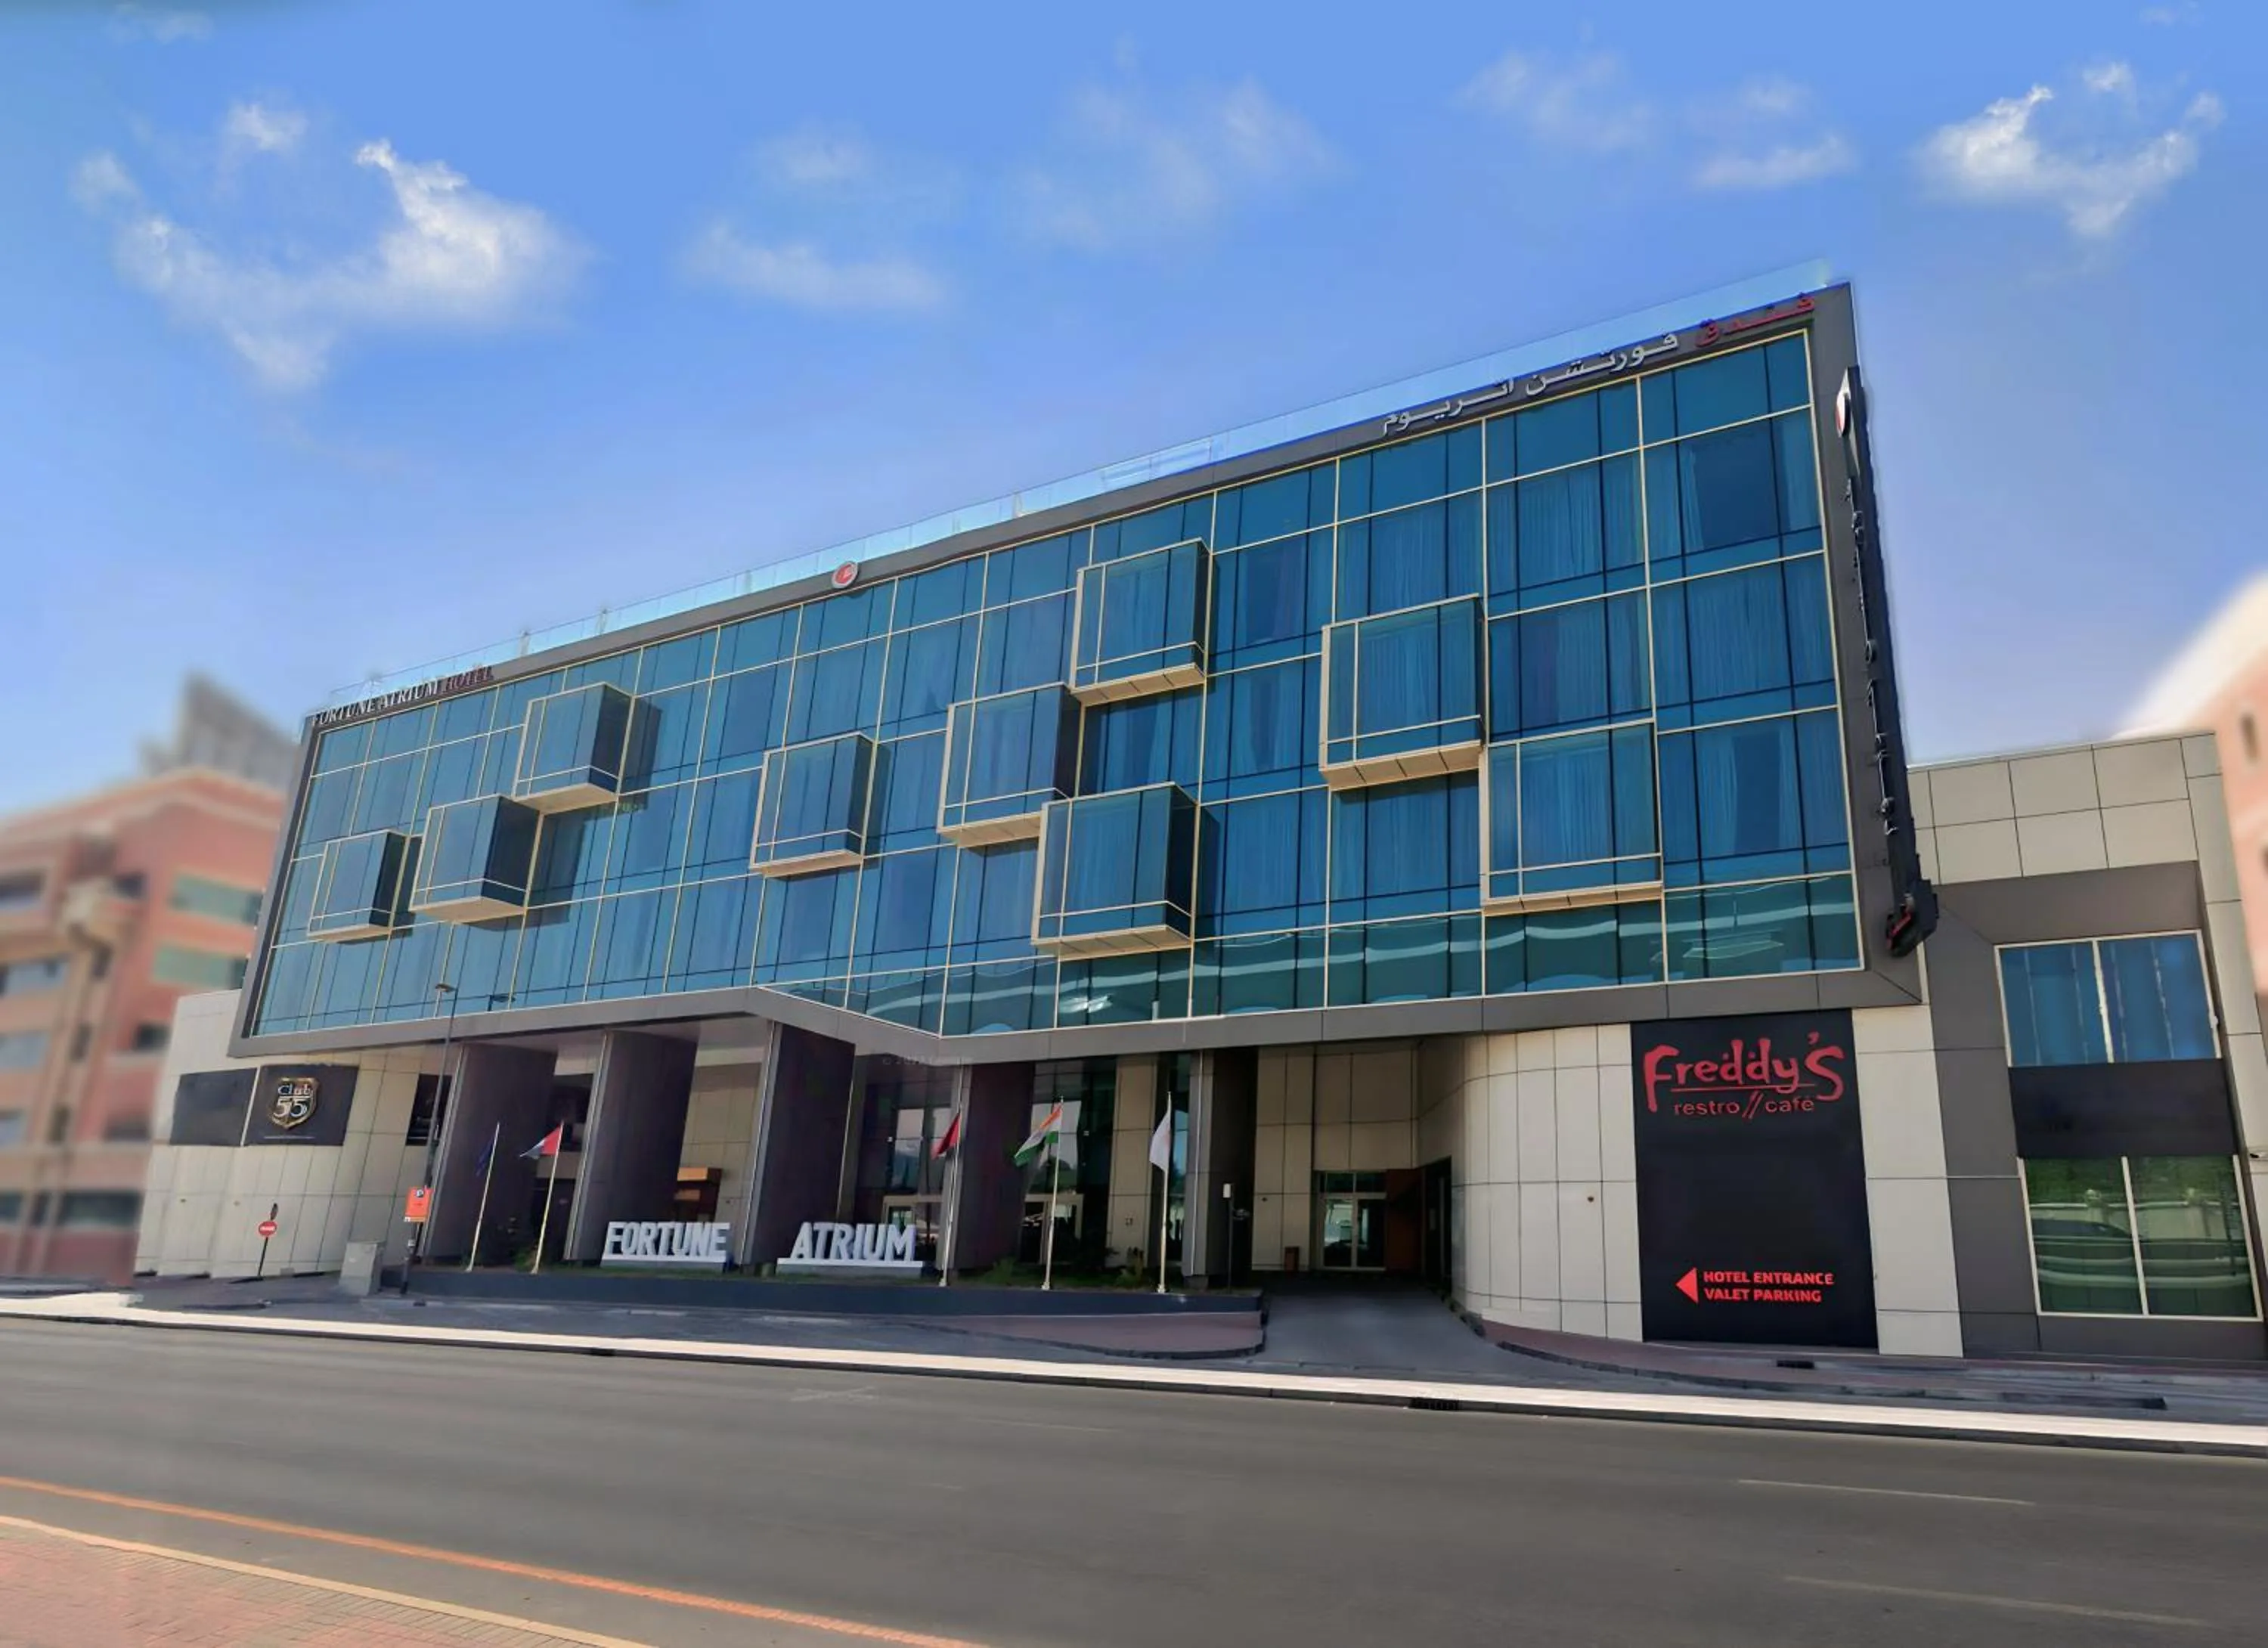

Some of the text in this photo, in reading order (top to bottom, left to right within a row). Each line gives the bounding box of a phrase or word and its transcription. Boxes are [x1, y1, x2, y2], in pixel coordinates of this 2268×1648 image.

[312, 666, 494, 725] FORTUNE ATRIUM HOTEL
[1643, 1031, 1845, 1113] Freddy's
[273, 1098, 308, 1118] 55
[1673, 1100, 1740, 1116] restro
[605, 1222, 916, 1261] FORTUNE ATRIUM
[1703, 1271, 1834, 1286] HOTEL ENTRANCE
[1703, 1288, 1822, 1303] VALET PARKING
